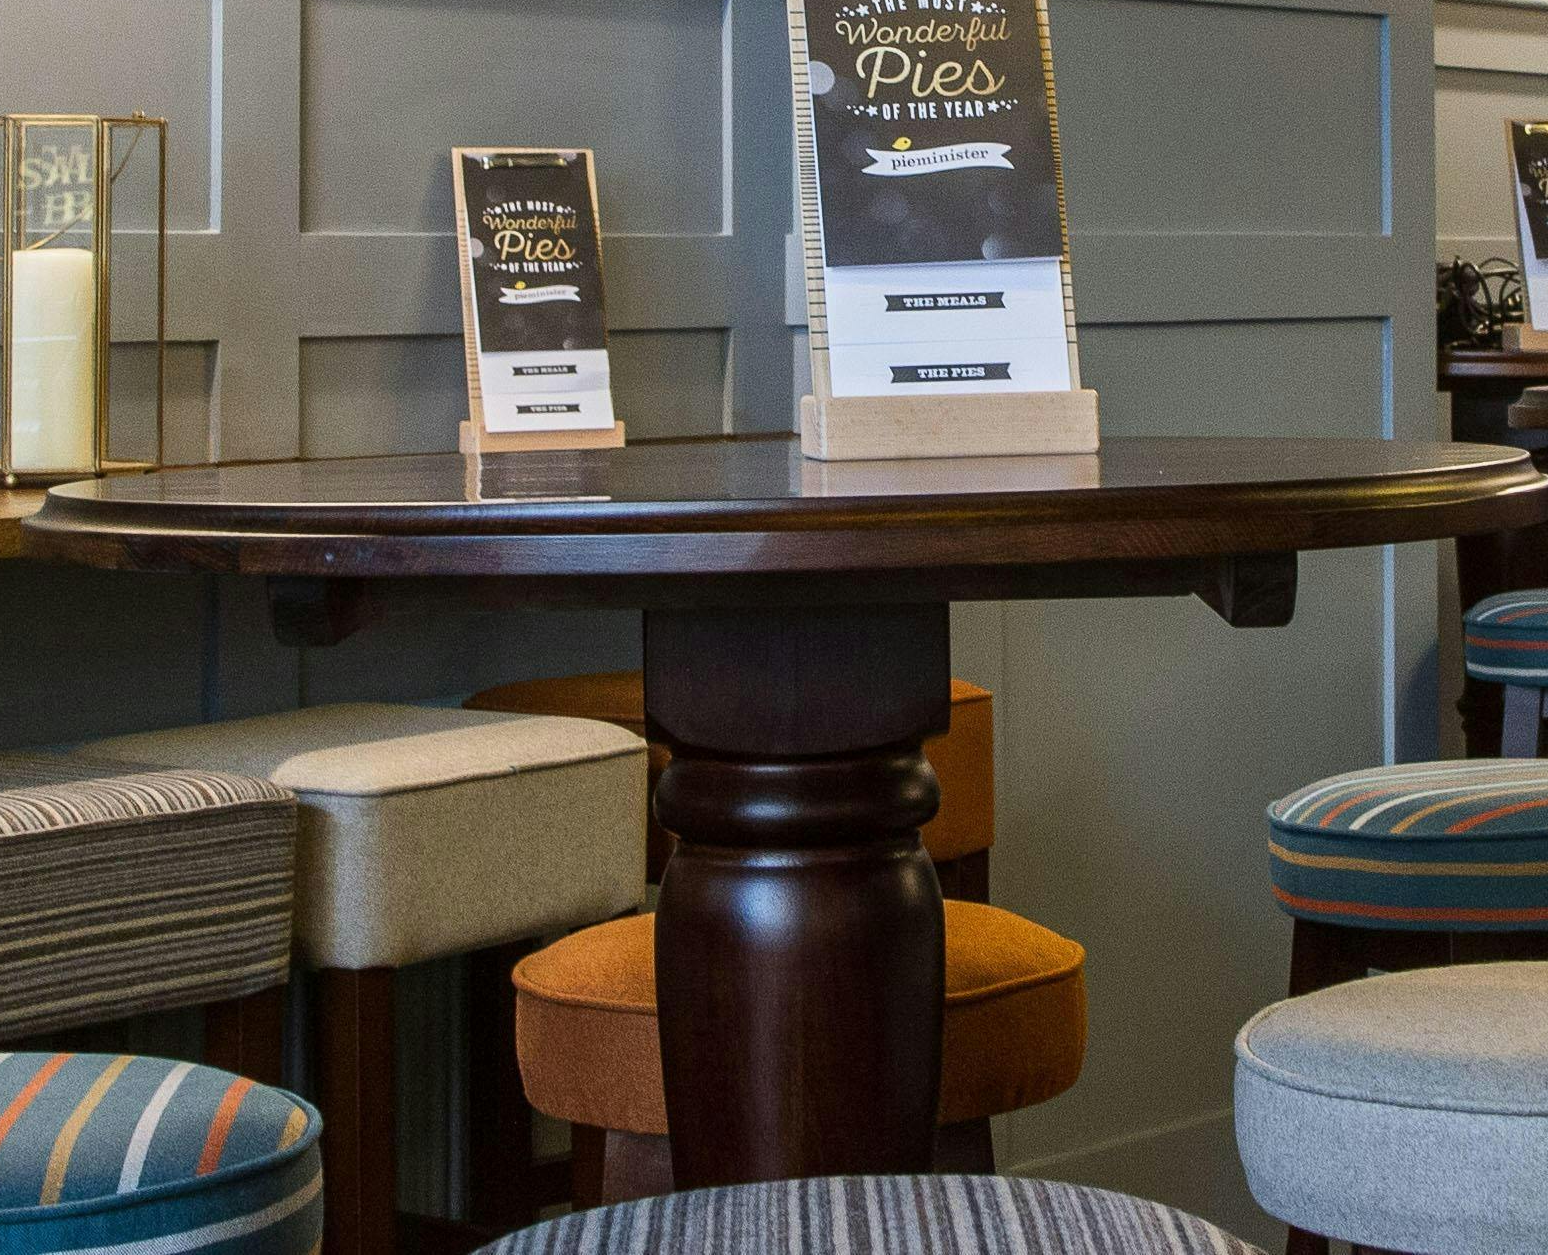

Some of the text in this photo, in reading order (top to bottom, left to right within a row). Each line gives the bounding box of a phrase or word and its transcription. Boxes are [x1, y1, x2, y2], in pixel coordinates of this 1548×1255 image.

[835, 16, 1011, 51] Wonderful
[855, 46, 1005, 99] Pies
[882, 100, 985, 120] OF THE YEAR
[891, 148, 989, 170] pieminister
[482, 214, 577, 235] Wonderful
[494, 230, 576, 261] Pies
[903, 295, 987, 307] THE MEALS
[917, 367, 986, 379] THE PIES
